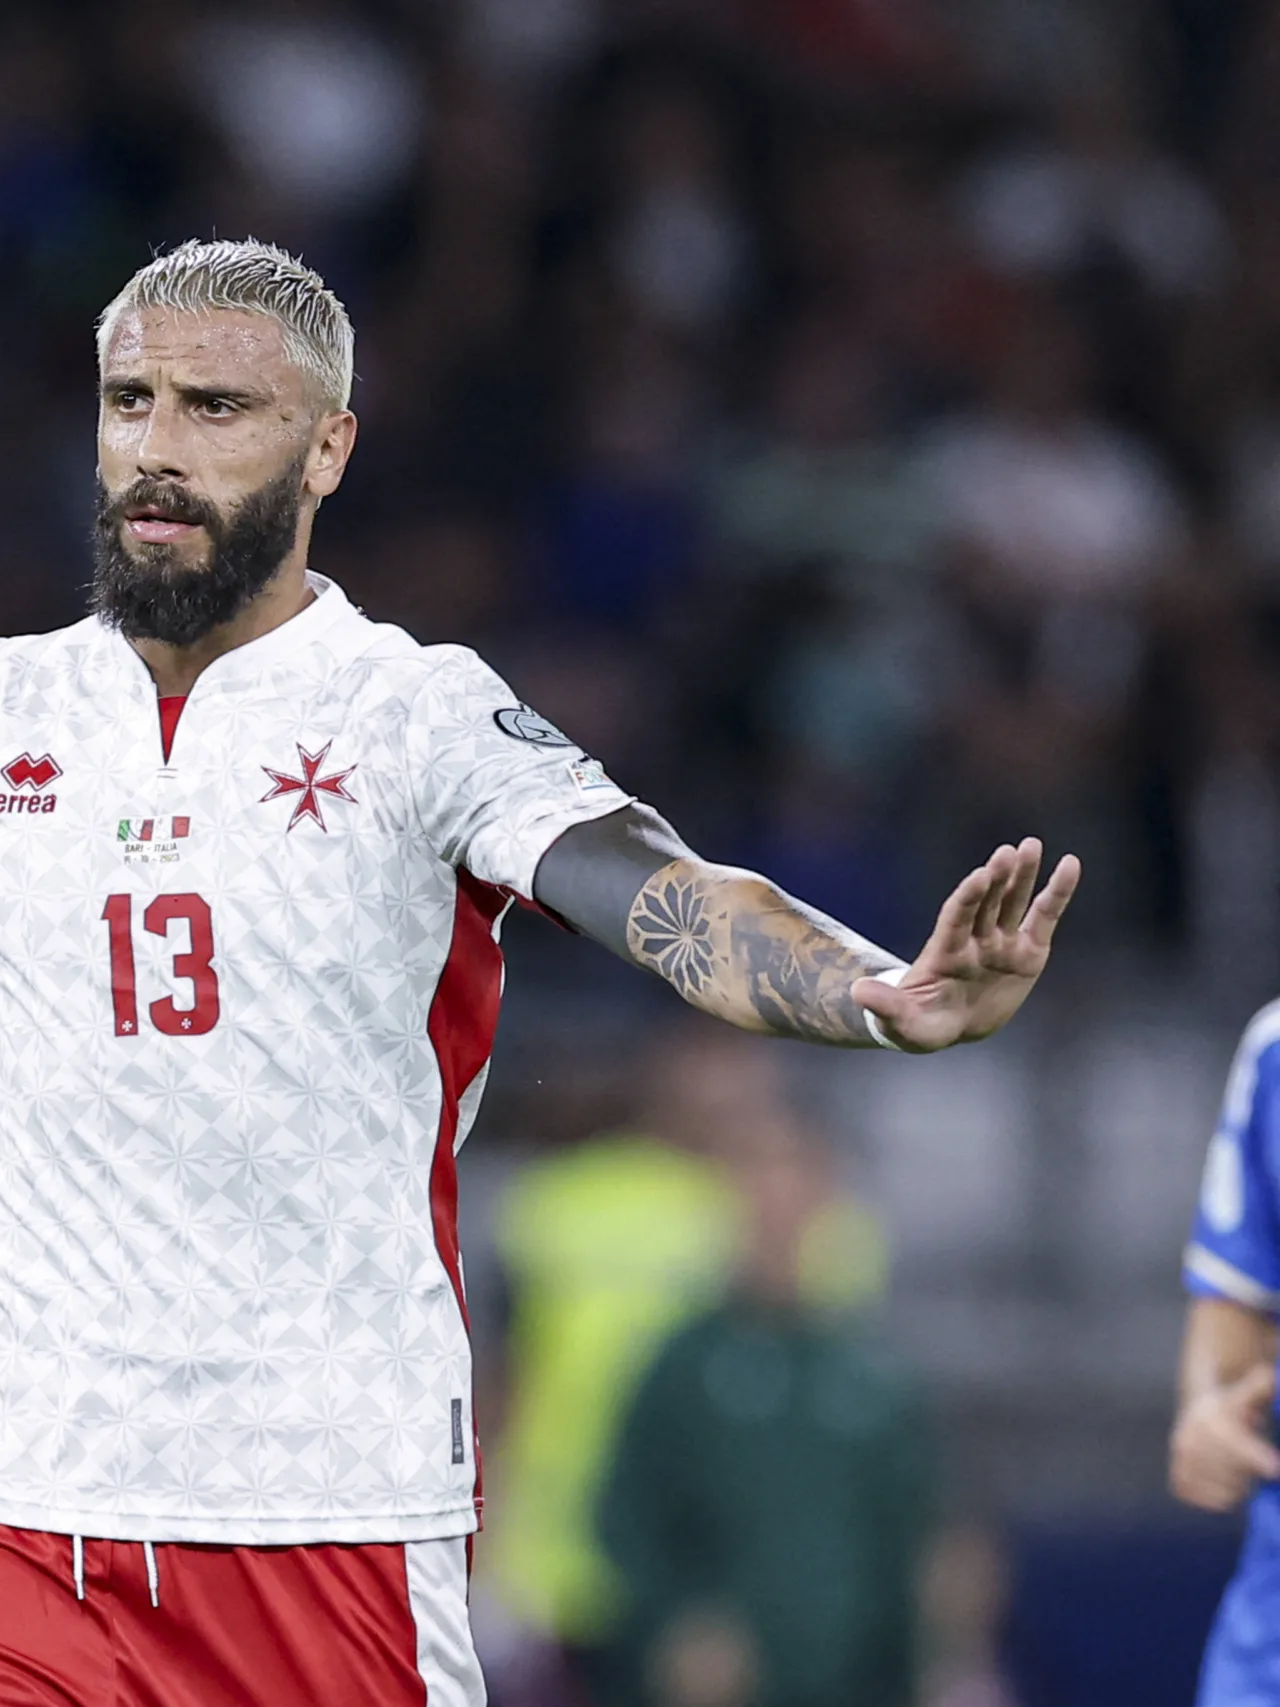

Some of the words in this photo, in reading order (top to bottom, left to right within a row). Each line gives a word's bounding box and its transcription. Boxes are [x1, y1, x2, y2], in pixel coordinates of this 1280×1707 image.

[125, 844, 144, 853] BARI
[154, 842, 177, 852] ITALIA
[101, 893, 220, 1037] 13
